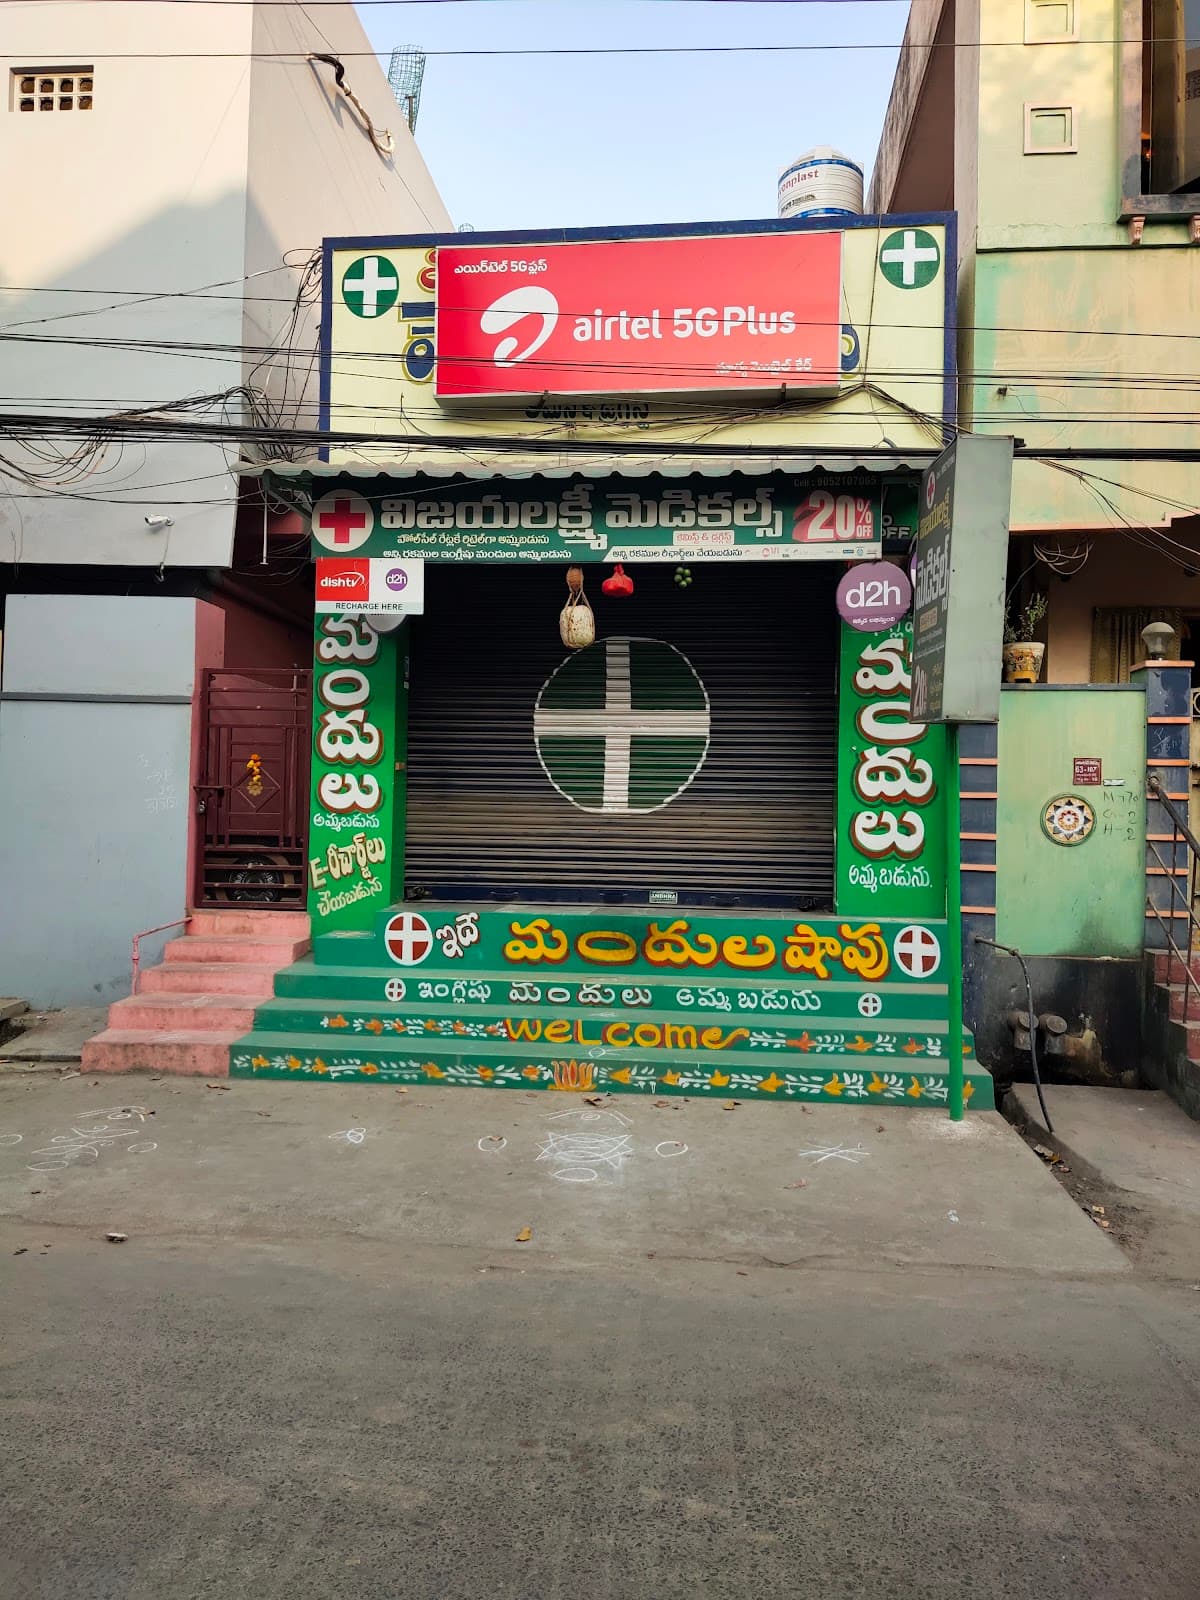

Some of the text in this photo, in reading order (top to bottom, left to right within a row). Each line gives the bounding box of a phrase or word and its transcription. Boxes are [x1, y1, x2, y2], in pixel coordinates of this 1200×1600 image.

[572, 308, 662, 342] airtel
[605, 487, 783, 537] మెడికల్స్
[498, 534, 550, 547] అమ్మబడును
[856, 526, 872, 538] OFF
[386, 573, 407, 584] d2h
[845, 580, 901, 608] d2h
[335, 602, 404, 611] RECHARGE HERE
[313, 812, 380, 833] అమ్మబడును
[435, 911, 480, 959] ఇదే
[784, 923, 890, 981] షాపు
